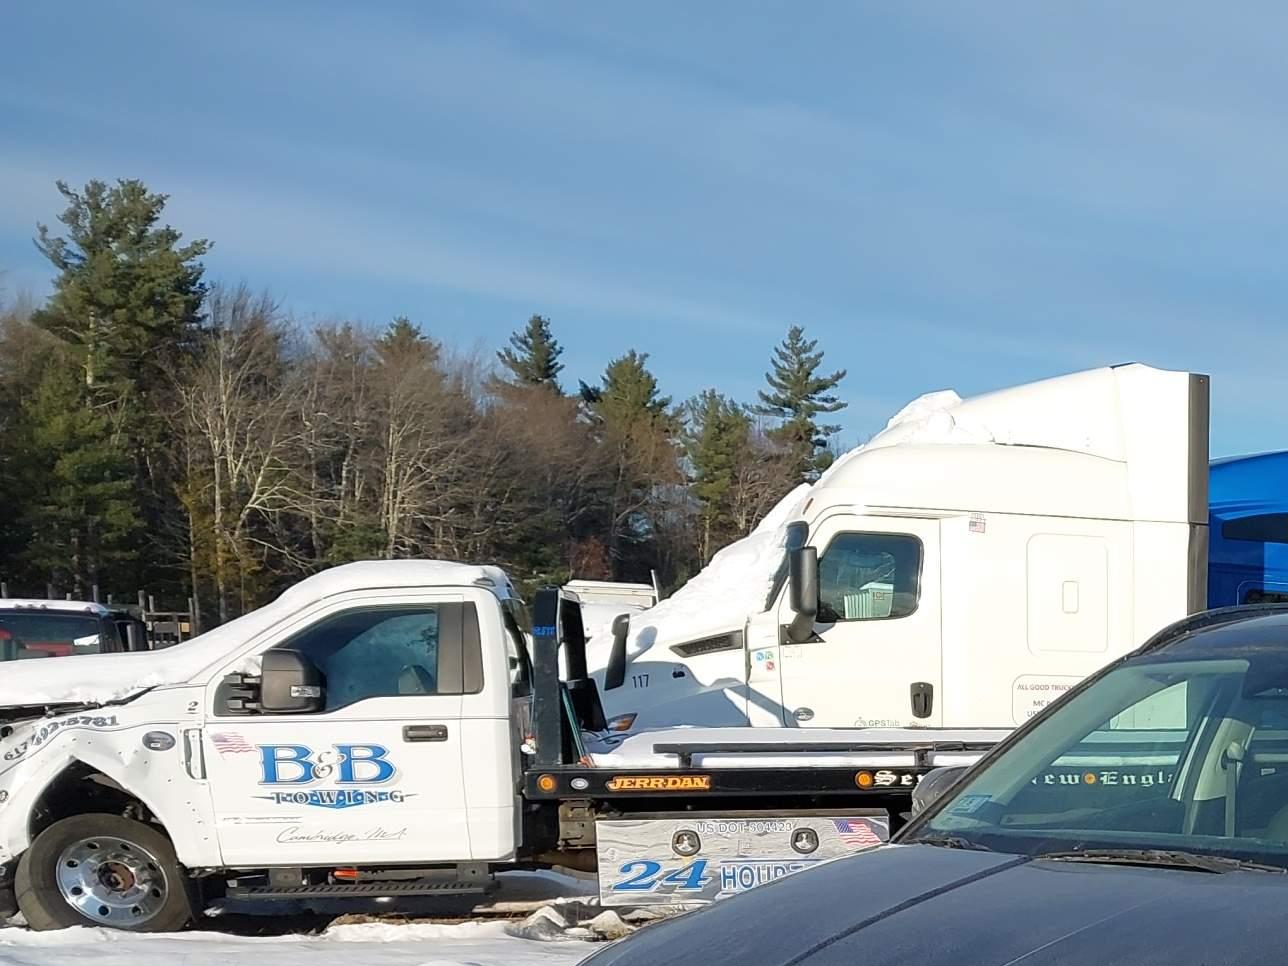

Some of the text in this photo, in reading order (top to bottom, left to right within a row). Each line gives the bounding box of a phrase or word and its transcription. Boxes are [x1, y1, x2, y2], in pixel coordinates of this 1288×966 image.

[632, 675, 649, 689] 117
[187, 701, 199, 711] 2
[256, 743, 397, 786] B&B
[1031, 772, 1081, 785] ew
[269, 790, 405, 805] TOWING
[696, 822, 714, 833] US
[719, 822, 746, 833] DOT
[611, 857, 711, 892] 24
